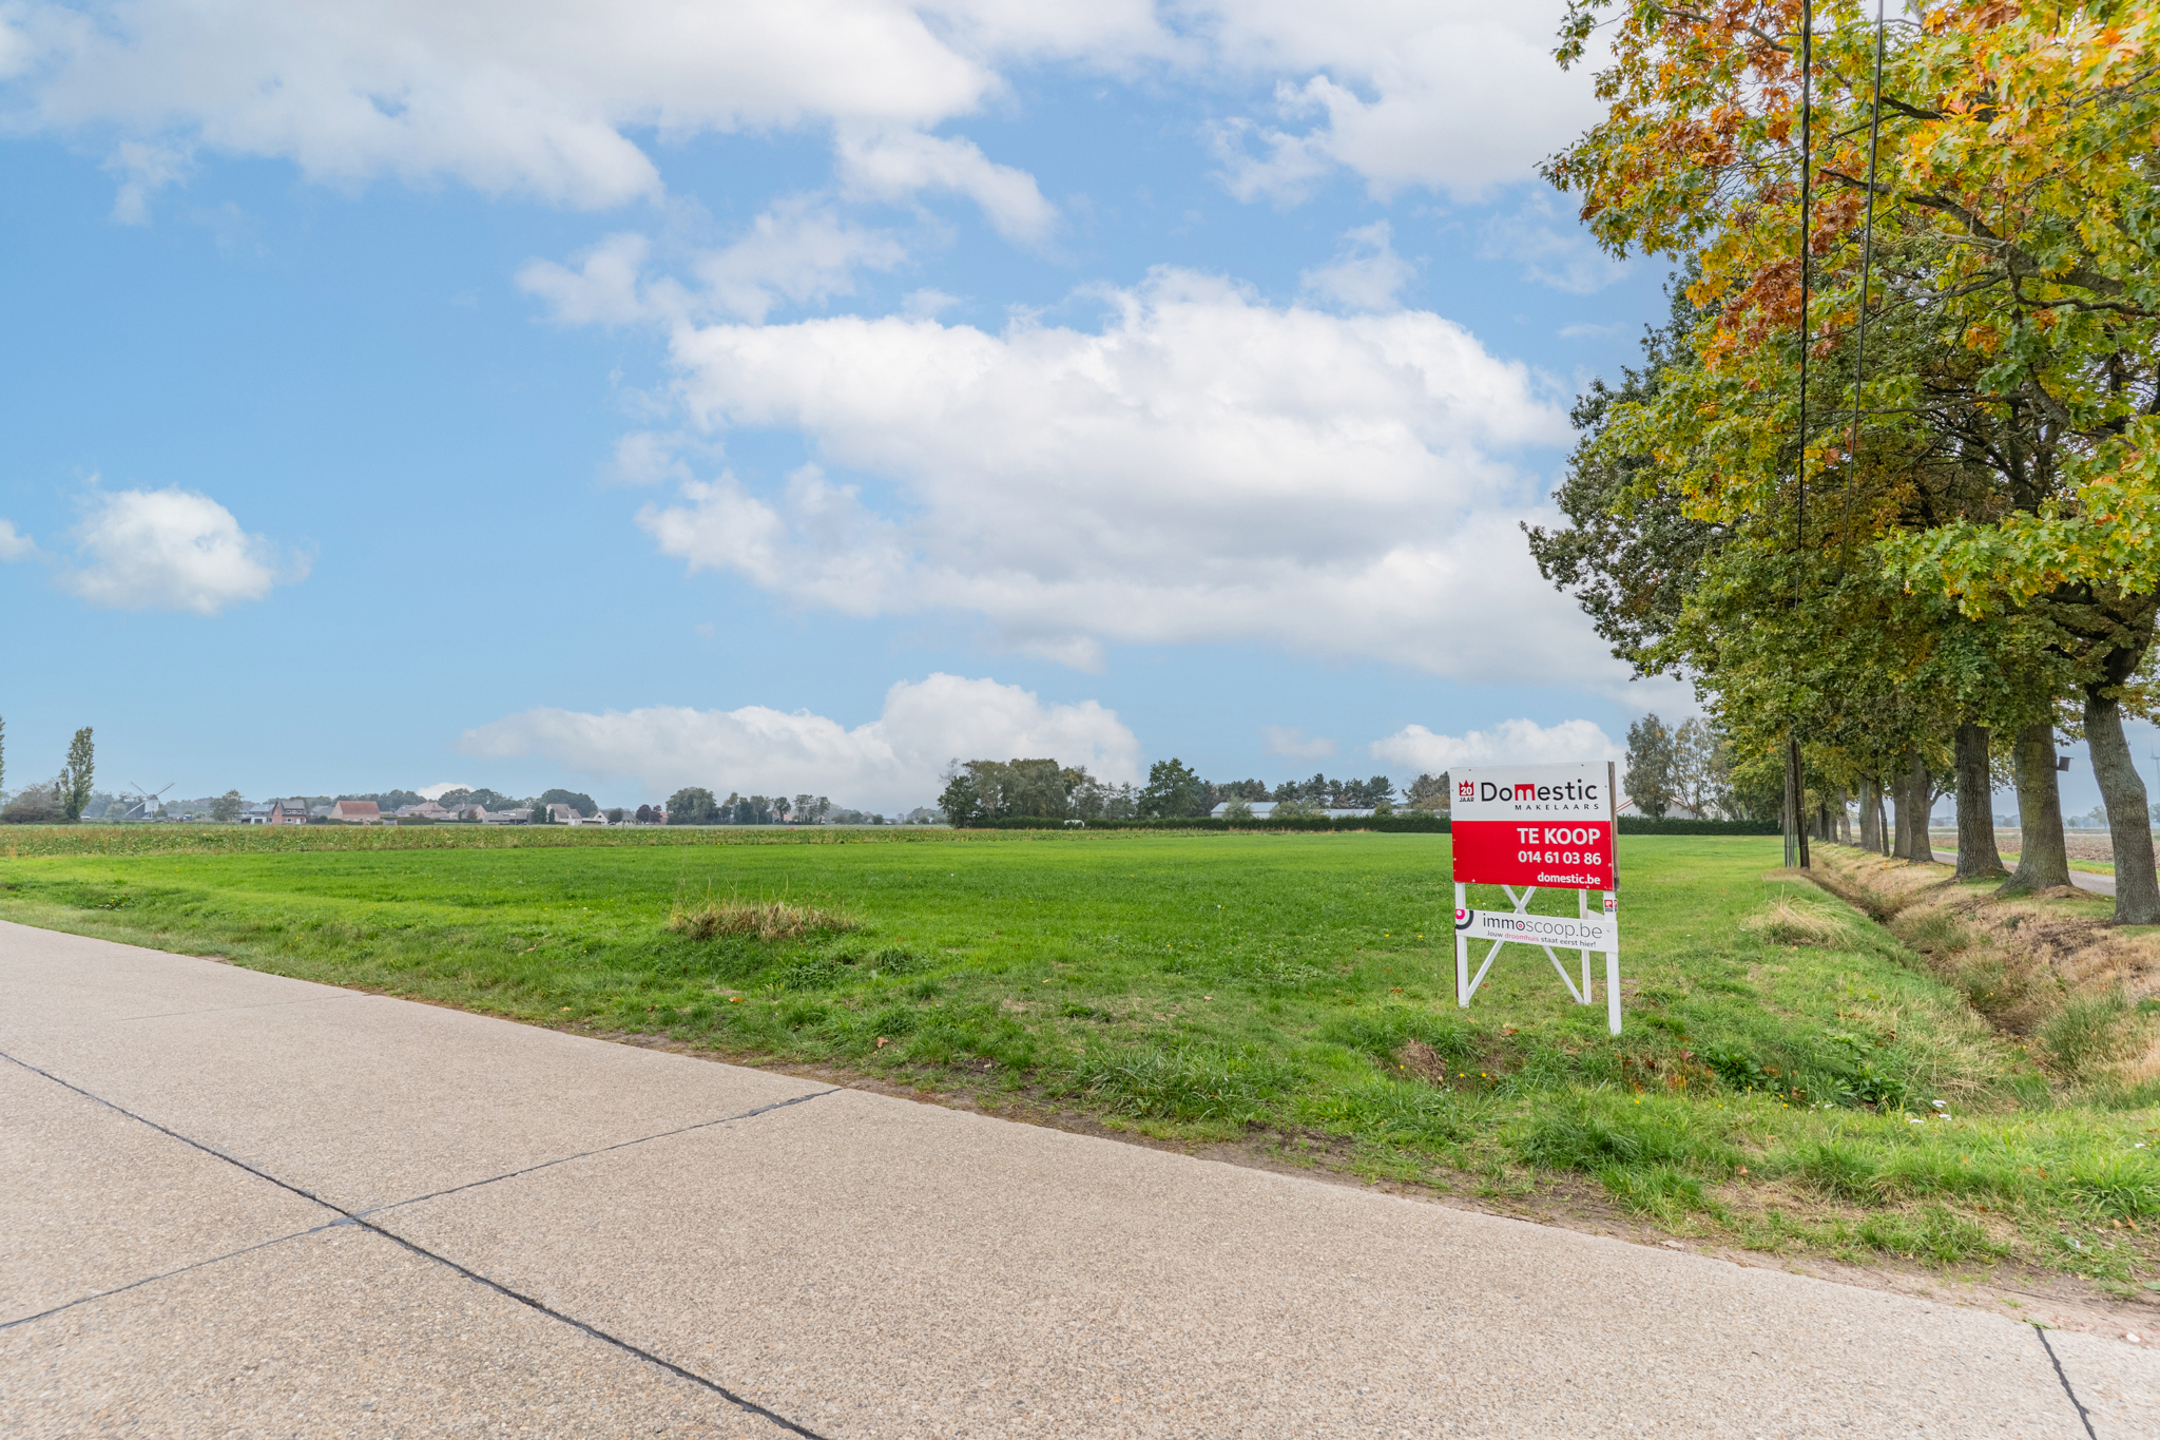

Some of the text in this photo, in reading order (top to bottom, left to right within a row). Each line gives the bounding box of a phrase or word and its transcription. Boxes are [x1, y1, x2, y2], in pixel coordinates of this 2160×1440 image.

[1460, 786, 1473, 795] 20
[1481, 778, 1598, 802] Domestic
[1516, 828, 1601, 845] TE KOOP
[1518, 850, 1602, 865] 014 61 03 86
[1537, 872, 1601, 885] domestic.be
[1483, 912, 1603, 939] immoscoop.be
[1504, 932, 1540, 942] droomhuis
